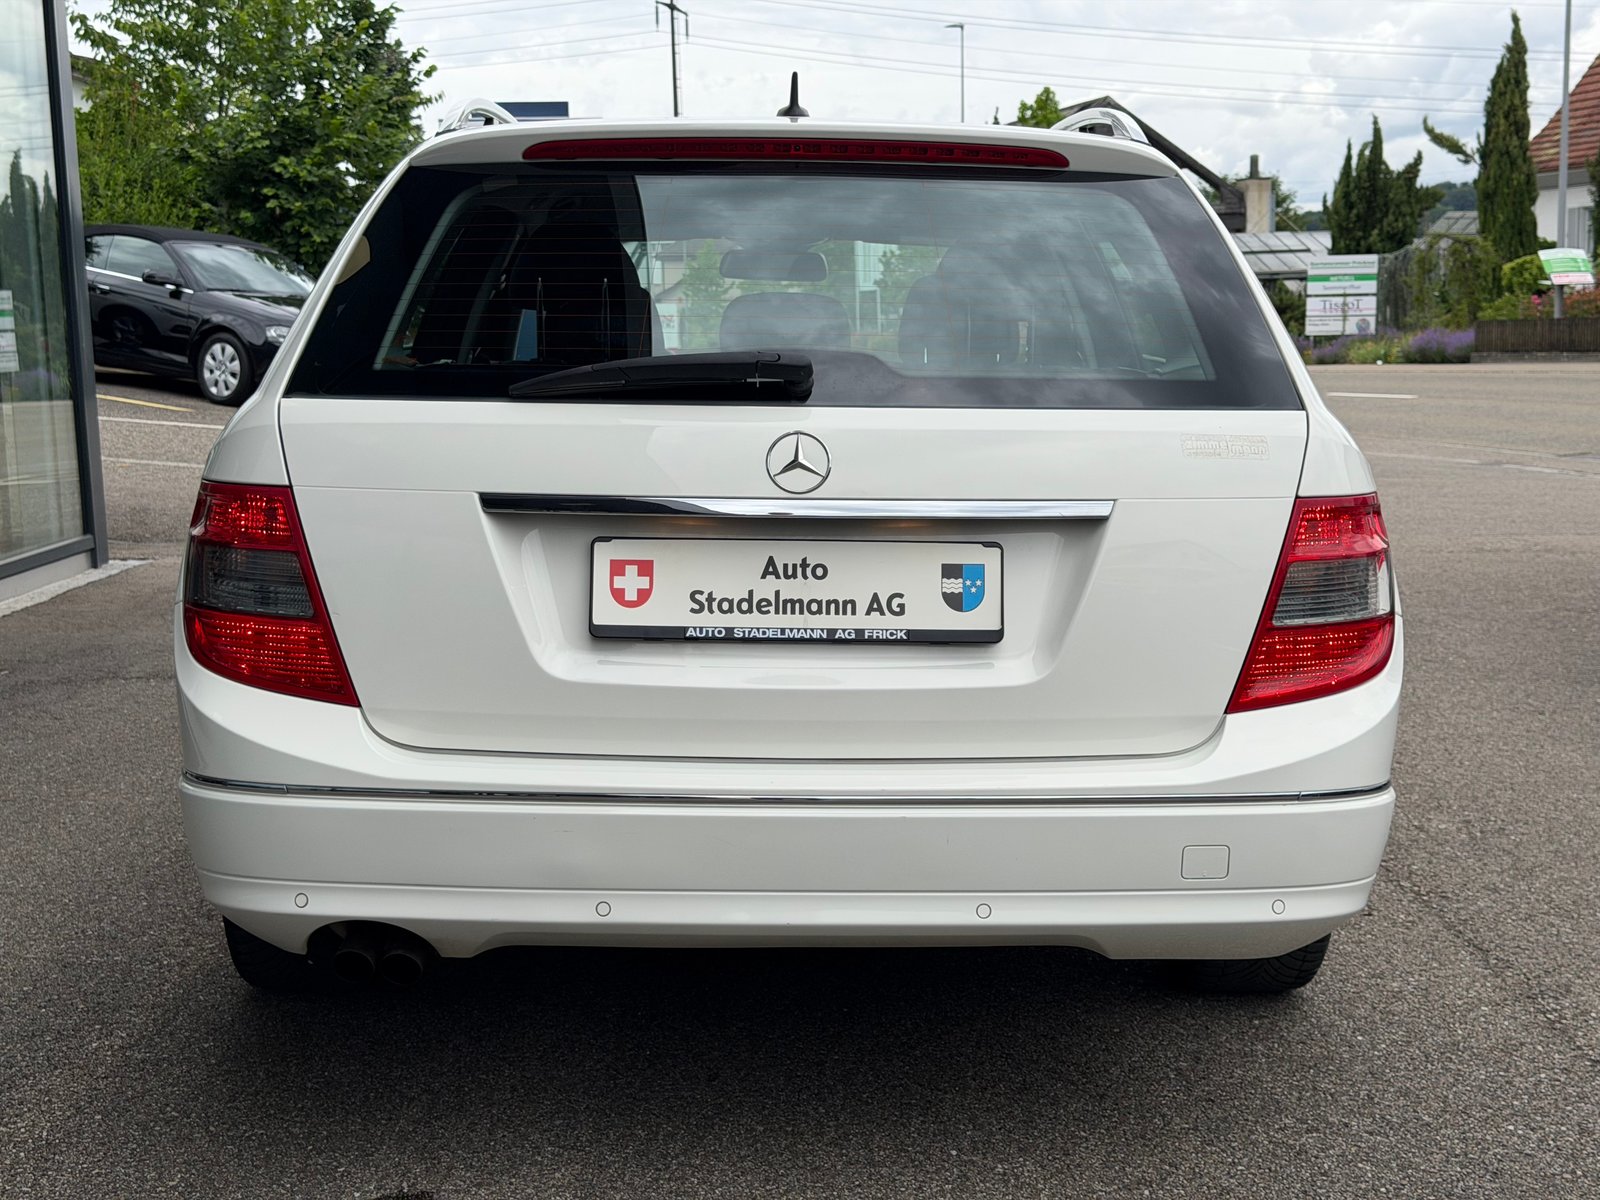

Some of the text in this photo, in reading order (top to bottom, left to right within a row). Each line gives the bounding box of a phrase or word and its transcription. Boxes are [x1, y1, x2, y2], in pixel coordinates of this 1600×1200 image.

[760, 555, 829, 581] Auto
[689, 589, 906, 617] Stadelmann AG
[686, 627, 908, 640] AUTO STADELMANN AG FRICK
